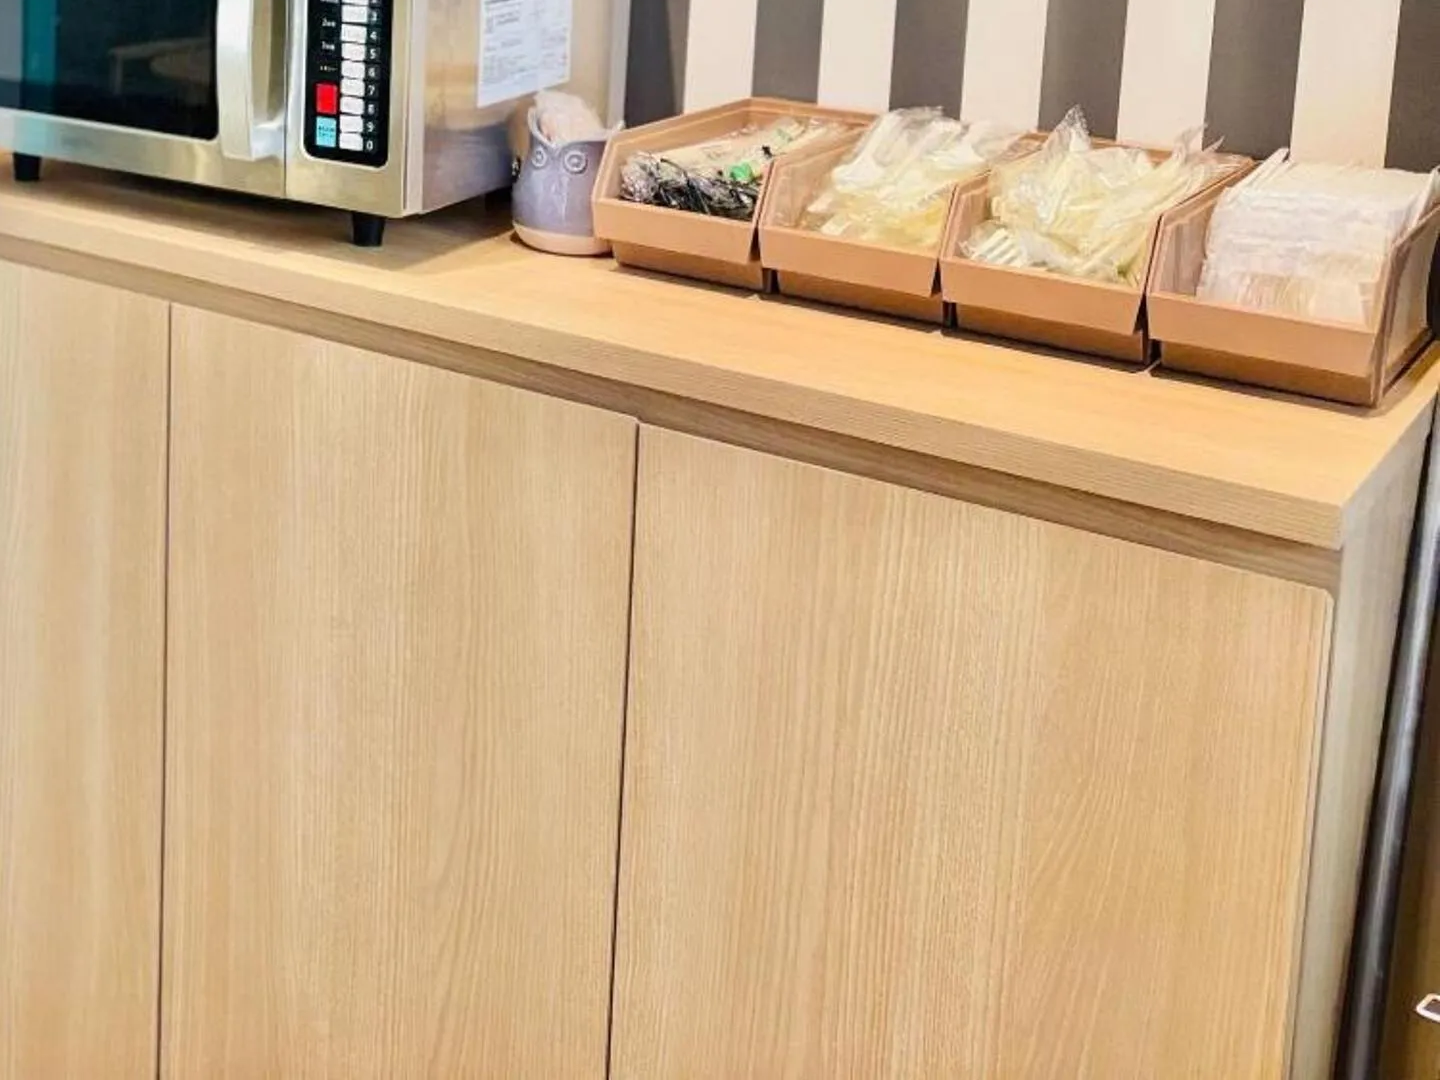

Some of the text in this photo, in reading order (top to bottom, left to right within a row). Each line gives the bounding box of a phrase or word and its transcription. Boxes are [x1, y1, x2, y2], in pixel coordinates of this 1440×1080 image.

[369, 48, 376, 59] 5
[368, 67, 376, 78] 6
[367, 84, 375, 95] 7
[366, 121, 374, 132] 9
[366, 140, 373, 151] 0
